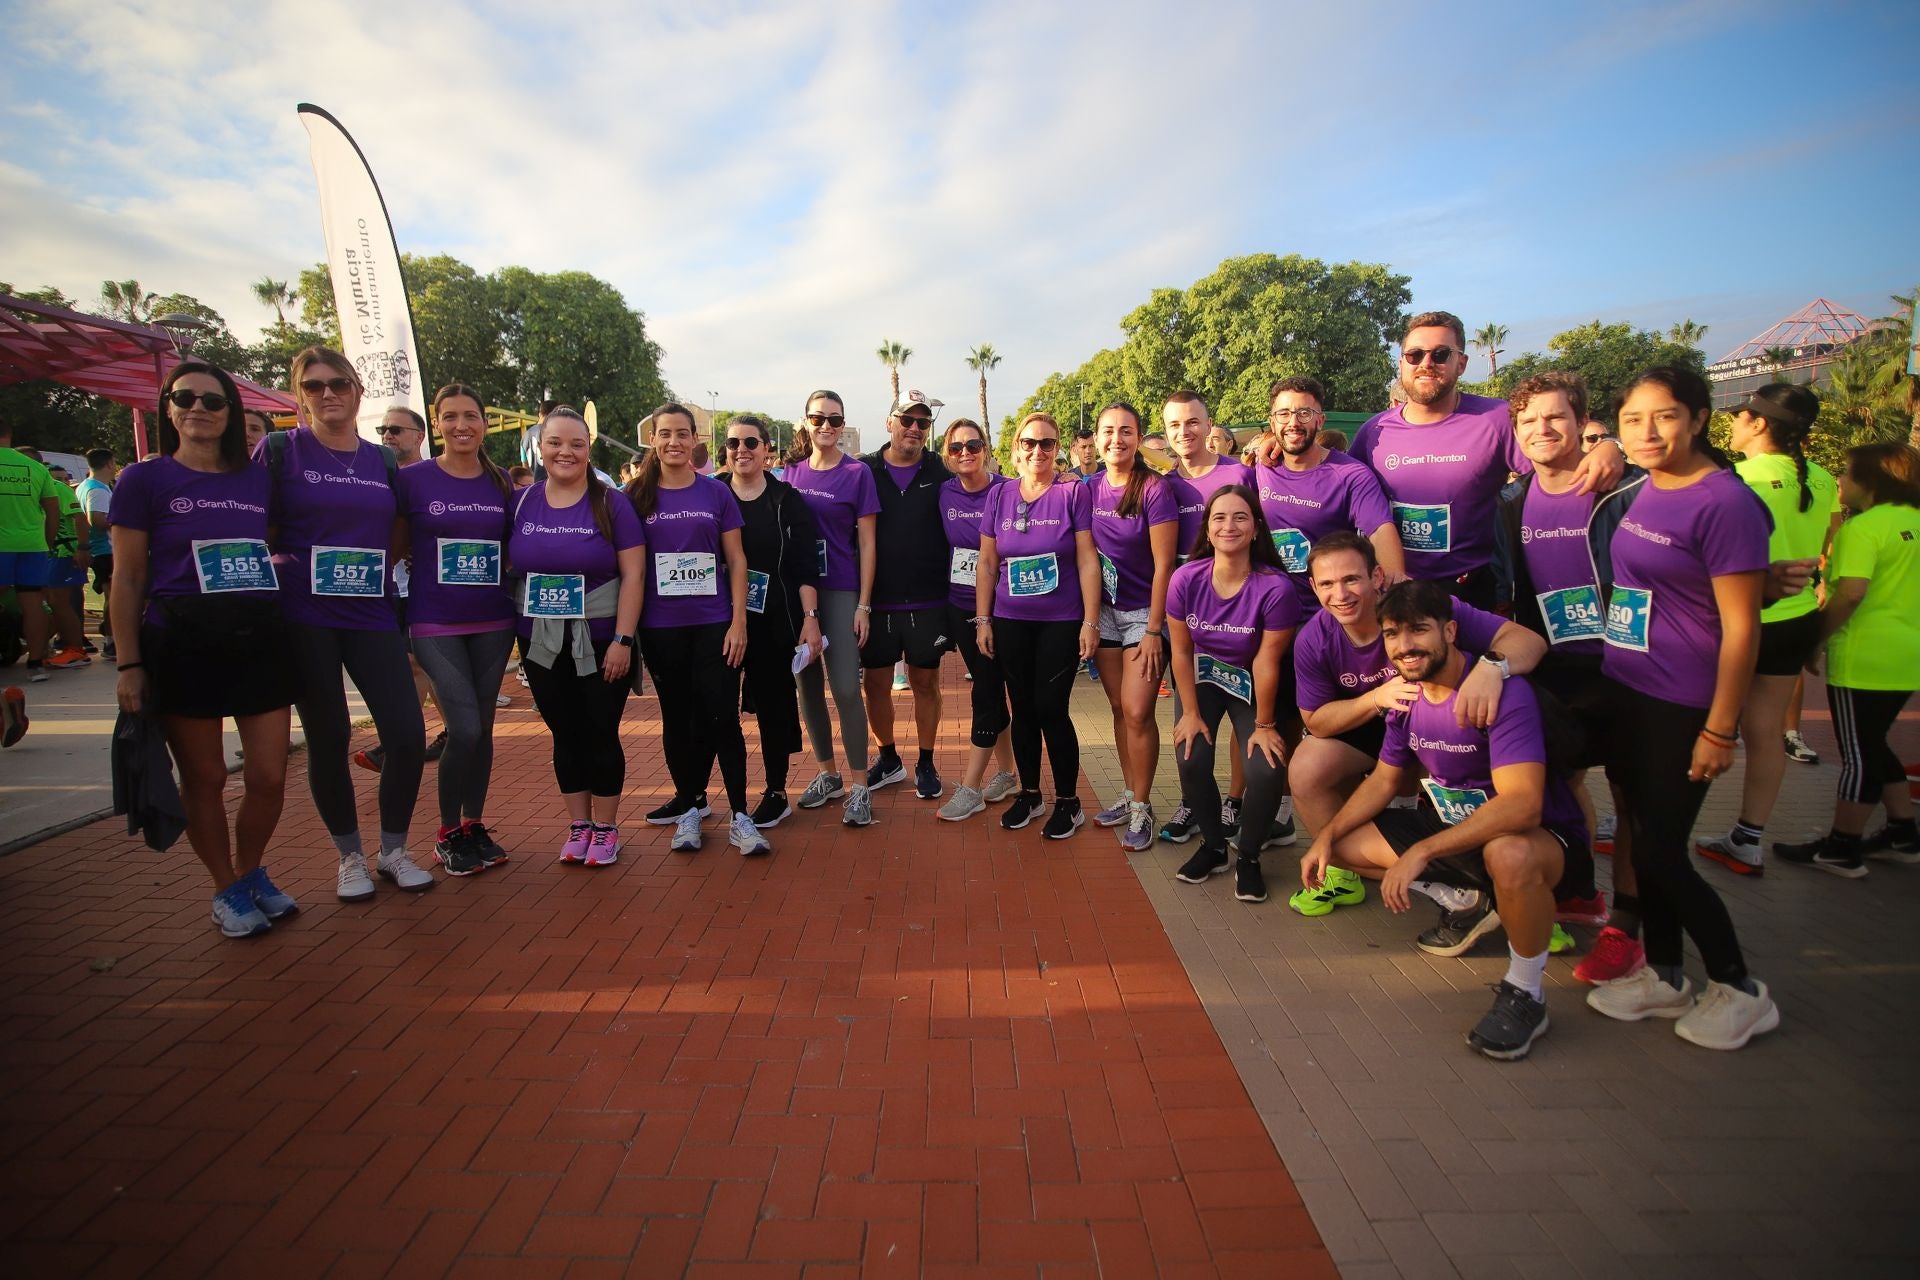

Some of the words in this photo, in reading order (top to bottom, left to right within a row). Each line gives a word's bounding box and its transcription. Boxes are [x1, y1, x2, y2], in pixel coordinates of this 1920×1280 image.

[1710, 366, 1751, 381] Seguridad
[1402, 456, 1424, 465] Grant
[1424, 454, 1467, 464] Thornton
[325, 473, 351, 484] Grant
[1270, 491, 1289, 503] Grant
[197, 499, 228, 510] Grant
[448, 503, 472, 512] Grant
[1179, 505, 1196, 514] Grant
[659, 512, 682, 520] Grant
[958, 510, 974, 518] Grant
[1095, 507, 1111, 517] Grant
[536, 525, 557, 534] Grant
[1402, 520, 1432, 535] 539
[1534, 529, 1559, 539] Grant
[221, 557, 260, 573] 555
[457, 555, 488, 569] 543
[960, 561, 978, 571] 21
[333, 564, 368, 579] 557
[669, 568, 706, 581] 2108
[1019, 569, 1044, 582] 541
[539, 588, 569, 601] 552
[1564, 602, 1598, 620] 554
[1200, 621, 1222, 632] Grant
[1360, 671, 1382, 684] Grant
[1419, 737, 1440, 749] Grant
